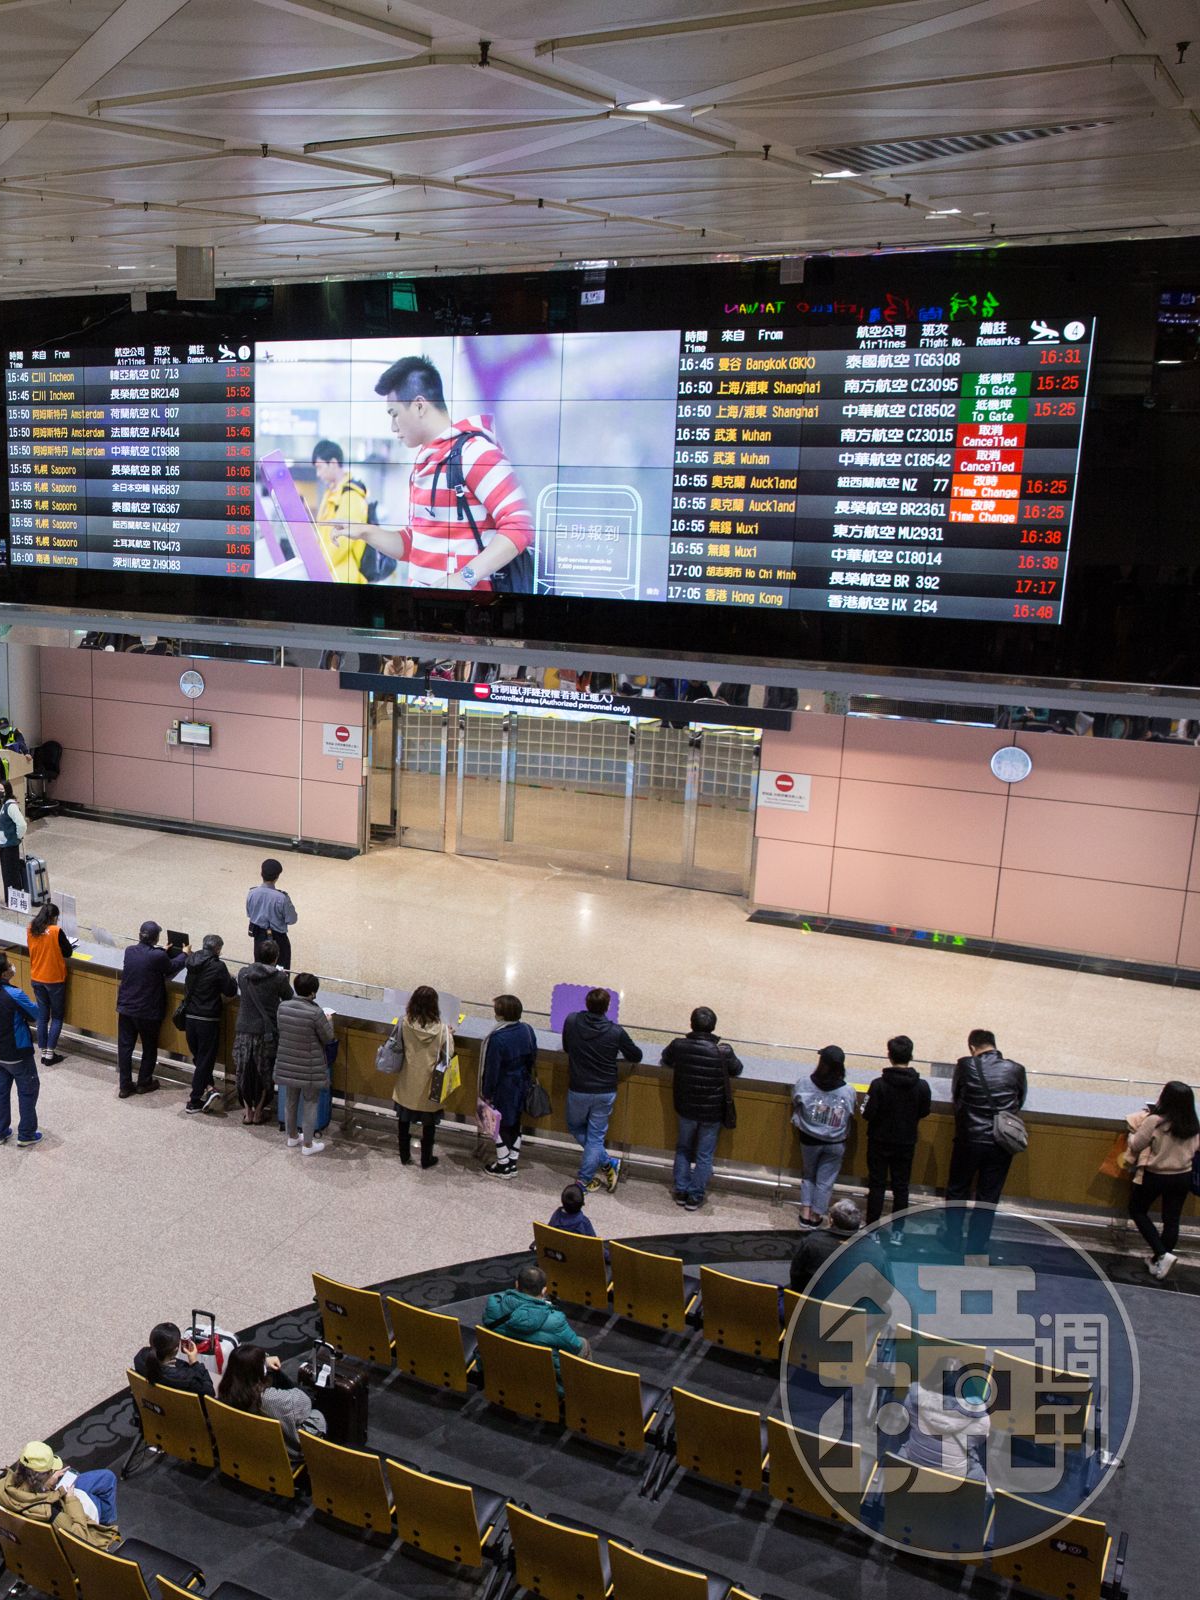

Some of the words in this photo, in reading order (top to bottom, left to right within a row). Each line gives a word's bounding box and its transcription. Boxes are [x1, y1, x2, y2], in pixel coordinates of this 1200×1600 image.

[685, 331, 708, 343] 時間
[722, 330, 745, 342] 來自
[758, 329, 783, 340] From
[856, 325, 906, 338] 航空公司
[922, 324, 948, 336] 班次
[980, 322, 1007, 335] 備註
[685, 344, 706, 353] Time
[859, 339, 906, 349] Airlines
[920, 338, 949, 348] Flight
[951, 336, 965, 346] No.
[976, 336, 1021, 346] Remarks
[680, 358, 714, 371] 16:45
[718, 358, 741, 371] 曼谷
[846, 354, 910, 368] 泰國航空
[914, 353, 960, 367] TG6308
[1039, 350, 1081, 365] 16:31
[8, 372, 29, 382] 15:45
[32, 372, 45, 382] 仁川
[49, 373, 75, 382] Incheon
[164, 369, 179, 378] 713
[226, 367, 250, 377] 15:52
[978, 373, 1015, 385] 抵機坪
[679, 382, 712, 394] 16:50
[717, 381, 769, 395] 上海/浦東
[774, 381, 821, 394] Shanghai
[844, 379, 908, 393] 南方航空
[910, 378, 958, 393] CZ3095
[1037, 376, 1080, 391] 15:25
[975, 385, 987, 396] To
[991, 385, 1016, 396] Gate
[8, 391, 29, 400] 15:45
[32, 391, 46, 401] 仁川
[50, 391, 75, 400] Incheon
[110, 388, 149, 400] 長榮航空
[151, 388, 179, 398] BR2149
[226, 387, 250, 398] 15:52
[677, 405, 712, 418] 16:50
[716, 405, 767, 419] 上海/浦東
[772, 406, 819, 419] Shanghai
[843, 404, 906, 419] 中華航空
[909, 404, 956, 418] CI8502
[1034, 402, 1077, 417] 15:25
[975, 399, 1013, 411] 抵機坪
[9, 410, 29, 419] 15:50
[71, 410, 105, 419] Amsterdam
[110, 408, 149, 419] 荷蘭航空
[151, 408, 160, 418] KL
[164, 408, 179, 418] 807
[972, 411, 985, 422] To
[989, 412, 1014, 422] Gate
[676, 428, 710, 441] 16:55
[714, 429, 737, 442] 武漢
[742, 429, 771, 442] Wuhan
[840, 428, 904, 443] 南方航空
[907, 429, 953, 443] CZ3015
[979, 424, 1003, 436] 取消
[963, 436, 1018, 447] Cancelled
[675, 451, 708, 463] 16:55
[713, 452, 736, 465] 武漢
[740, 452, 770, 465] Wuhan
[839, 453, 902, 467] 中華航空
[904, 453, 951, 467] CI8542
[976, 450, 1000, 461] 取消
[10, 464, 31, 474] 15:55
[51, 465, 76, 475] Sapporo
[112, 465, 150, 476] 長榮航空
[152, 466, 161, 475] BR
[165, 466, 180, 476] 165
[226, 466, 250, 476] 16:05
[961, 461, 1015, 472] Cancelled
[674, 475, 707, 487] 16:55
[711, 475, 746, 489] 奧克蘭
[750, 476, 797, 490] Auckland
[837, 477, 900, 489] 紐西蘭航空
[902, 479, 918, 492] NZ
[933, 478, 949, 492] 77
[1025, 479, 1068, 494] 16:25
[953, 487, 977, 497] Time
[981, 488, 1018, 498] Change
[672, 497, 706, 510] 16:55
[710, 498, 745, 512] 奧克蘭
[749, 500, 795, 513] Auckland
[835, 501, 898, 515] 長榮航空
[900, 503, 946, 517] BR2361
[1023, 505, 1065, 519] 16:25
[951, 511, 975, 522] Time
[978, 512, 1015, 523] Change
[556, 524, 620, 541] 自助報到
[671, 519, 705, 532] 16:55
[709, 521, 732, 535] 無錫
[736, 522, 759, 535] Wuxi
[833, 524, 895, 539] 東方航空
[898, 527, 944, 541] MU2931
[1020, 529, 1062, 544] 16:38
[12, 553, 33, 563] 16:00
[53, 555, 78, 566] Nantong
[226, 562, 250, 573] 15:47
[670, 542, 703, 555] 16:55
[707, 544, 730, 557] 無錫
[735, 545, 757, 558] Wuxi
[831, 548, 893, 563] 中華航空
[896, 551, 943, 566] CI8014
[1018, 555, 1059, 569] 16:38
[669, 565, 702, 577] 17:00
[706, 566, 742, 578] 胡志明市
[745, 568, 755, 578] Ho
[759, 569, 772, 579] Chi
[776, 569, 796, 580] Minh
[829, 571, 892, 587] 長榮航空
[894, 574, 910, 588] BR
[915, 576, 940, 589] 392
[1015, 580, 1057, 594] 17:17
[668, 587, 701, 599] 17:05
[705, 589, 727, 602] 香港
[731, 590, 755, 604] Hong
[759, 592, 783, 605] Kong
[828, 594, 889, 610] 香港航空
[892, 598, 907, 611] HX
[913, 599, 938, 613] 254
[1013, 604, 1053, 619] 16:48
[490, 694, 523, 703] Controlled
[540, 697, 578, 709] (Authorized
[579, 702, 612, 712] personnel
[613, 705, 630, 713] only)
